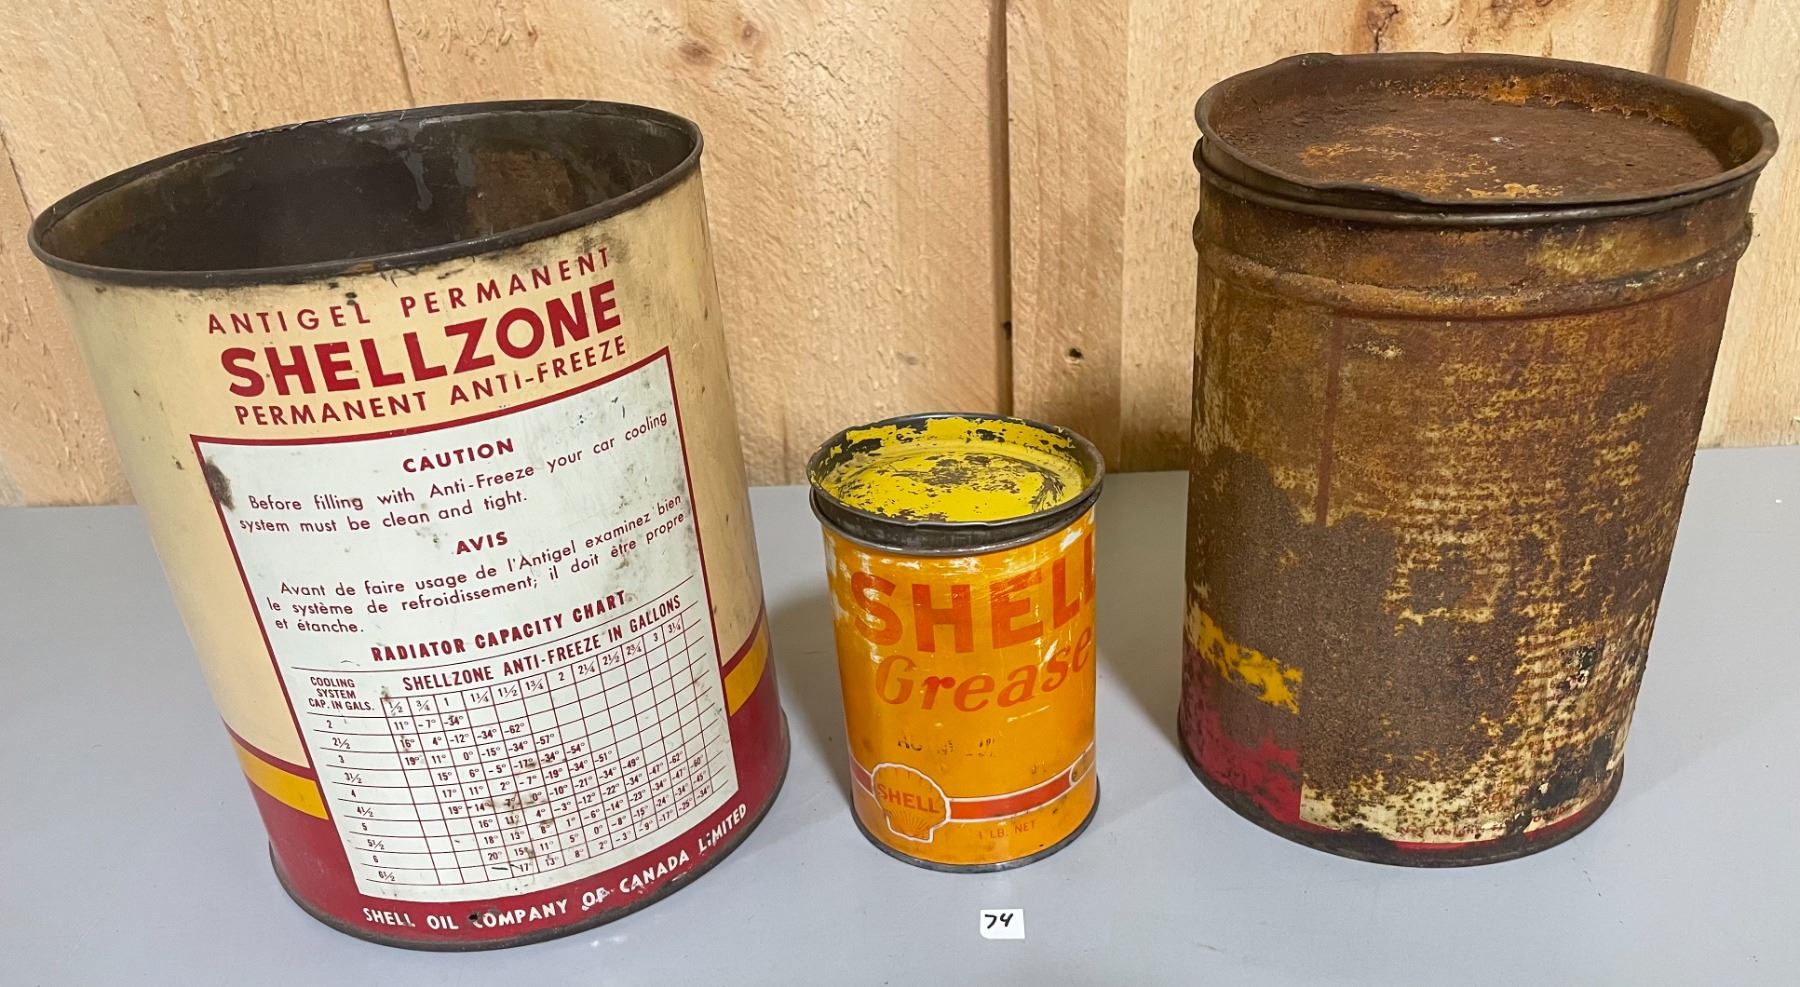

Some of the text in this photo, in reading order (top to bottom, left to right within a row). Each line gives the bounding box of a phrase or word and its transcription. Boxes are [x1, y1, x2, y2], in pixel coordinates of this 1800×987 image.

[208, 247, 610, 334] ANTIGEL PERMANENT
[221, 280, 621, 397] SHELLZONE
[234, 334, 626, 425] PERMANENT ANTI-FREEZE
[249, 410, 668, 514] Before filling with Anti-Freeze your car cooling
[403, 438, 514, 473] CAUTION
[240, 492, 527, 533] system must be clean and tight.
[280, 495, 683, 597] Avant de faire usage de l'Antigel examinez bien
[456, 532, 508, 555] AVIS
[267, 512, 686, 619] le système de refroidissement; il doit être propre
[276, 616, 365, 634] et étanche.
[371, 591, 626, 662] RADIATOR CAPACITY CHART
[402, 594, 681, 692] SHELLZONE ANTI-FREEZE IN GALLONS
[558, 672, 564, 681] 2
[653, 632, 658, 642] 3
[875, 626, 1092, 712] Grease
[310, 676, 355, 688] COOLING
[316, 688, 356, 699] SYSTEM
[326, 720, 333, 728] 2
[332, 701, 343, 710] IN
[345, 701, 375, 711] GALS.
[877, 784, 940, 814] SHELL
[361, 822, 368, 831] 5
[1014, 821, 1036, 836] NET
[363, 908, 416, 928] SHELL
[426, 915, 459, 930] OIL
[620, 850, 690, 893] CANADA
[698, 804, 747, 854] LIMITED
[985, 913, 1013, 929] 74
